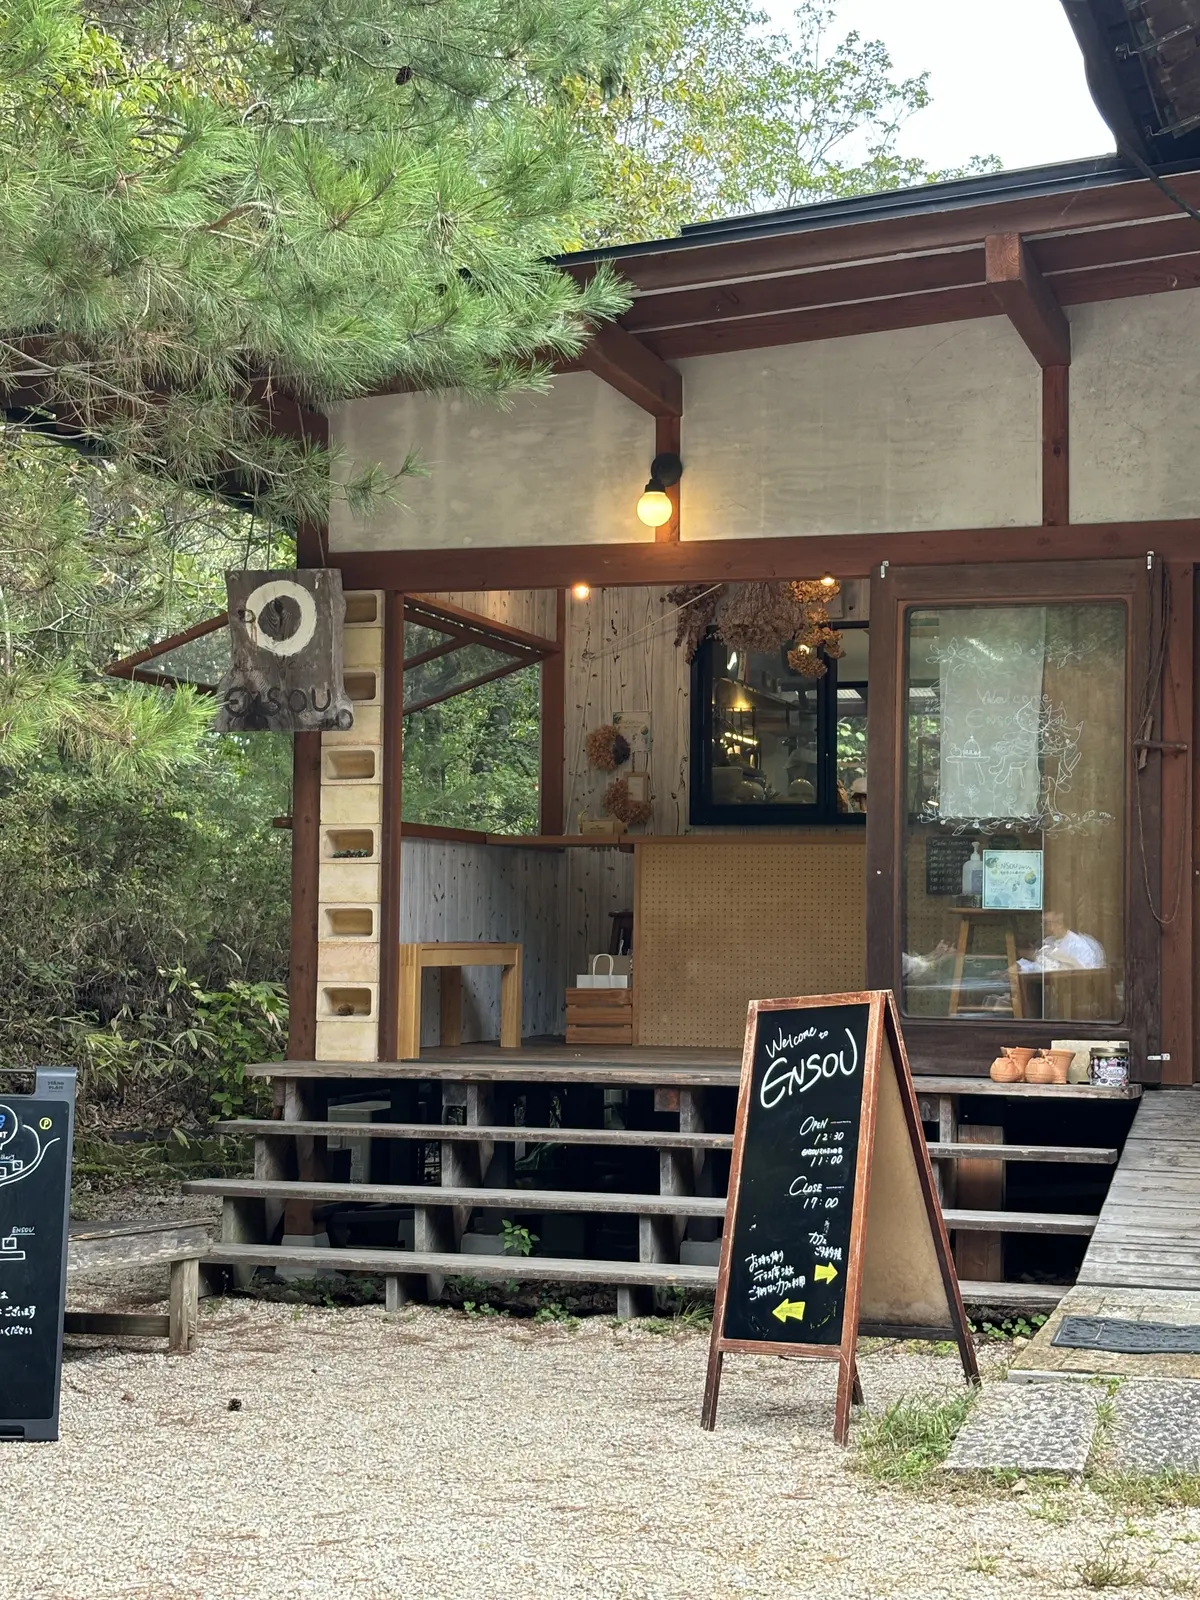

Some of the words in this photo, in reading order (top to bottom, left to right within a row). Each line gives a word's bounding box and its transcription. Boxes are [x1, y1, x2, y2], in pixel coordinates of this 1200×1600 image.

[765, 1027, 817, 1058] Welcome
[819, 1030, 829, 1040] to
[760, 1027, 858, 1109] ENSOU
[800, 1116, 829, 1135] OPEN
[814, 1131, 845, 1145] 12:30
[810, 1155, 843, 1167] 11:00
[789, 1176, 823, 1196] CLOSE
[804, 1197, 839, 1209] 17:00
[808, 1231, 827, 1245] カフェ
[0, 1305, 37, 1320] ございます
